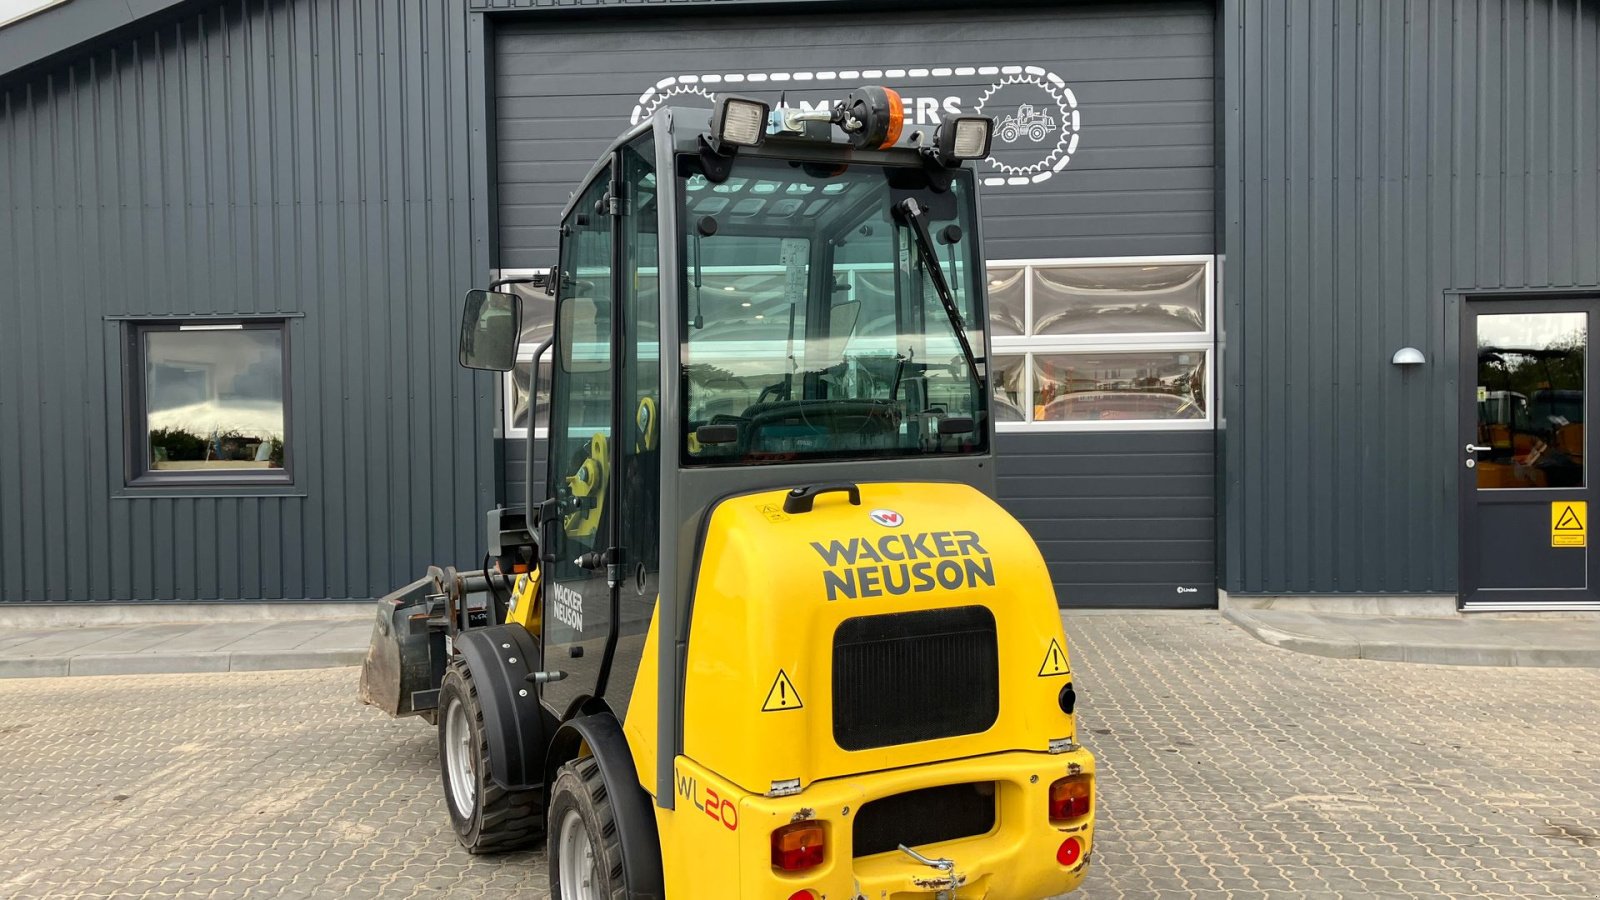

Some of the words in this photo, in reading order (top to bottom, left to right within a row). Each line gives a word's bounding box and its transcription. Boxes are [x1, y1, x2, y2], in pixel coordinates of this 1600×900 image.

[809, 530, 989, 567] WACKER
[823, 557, 996, 601] NEUSON
[553, 581, 583, 613] WACKER
[553, 600, 583, 633] NEUSON
